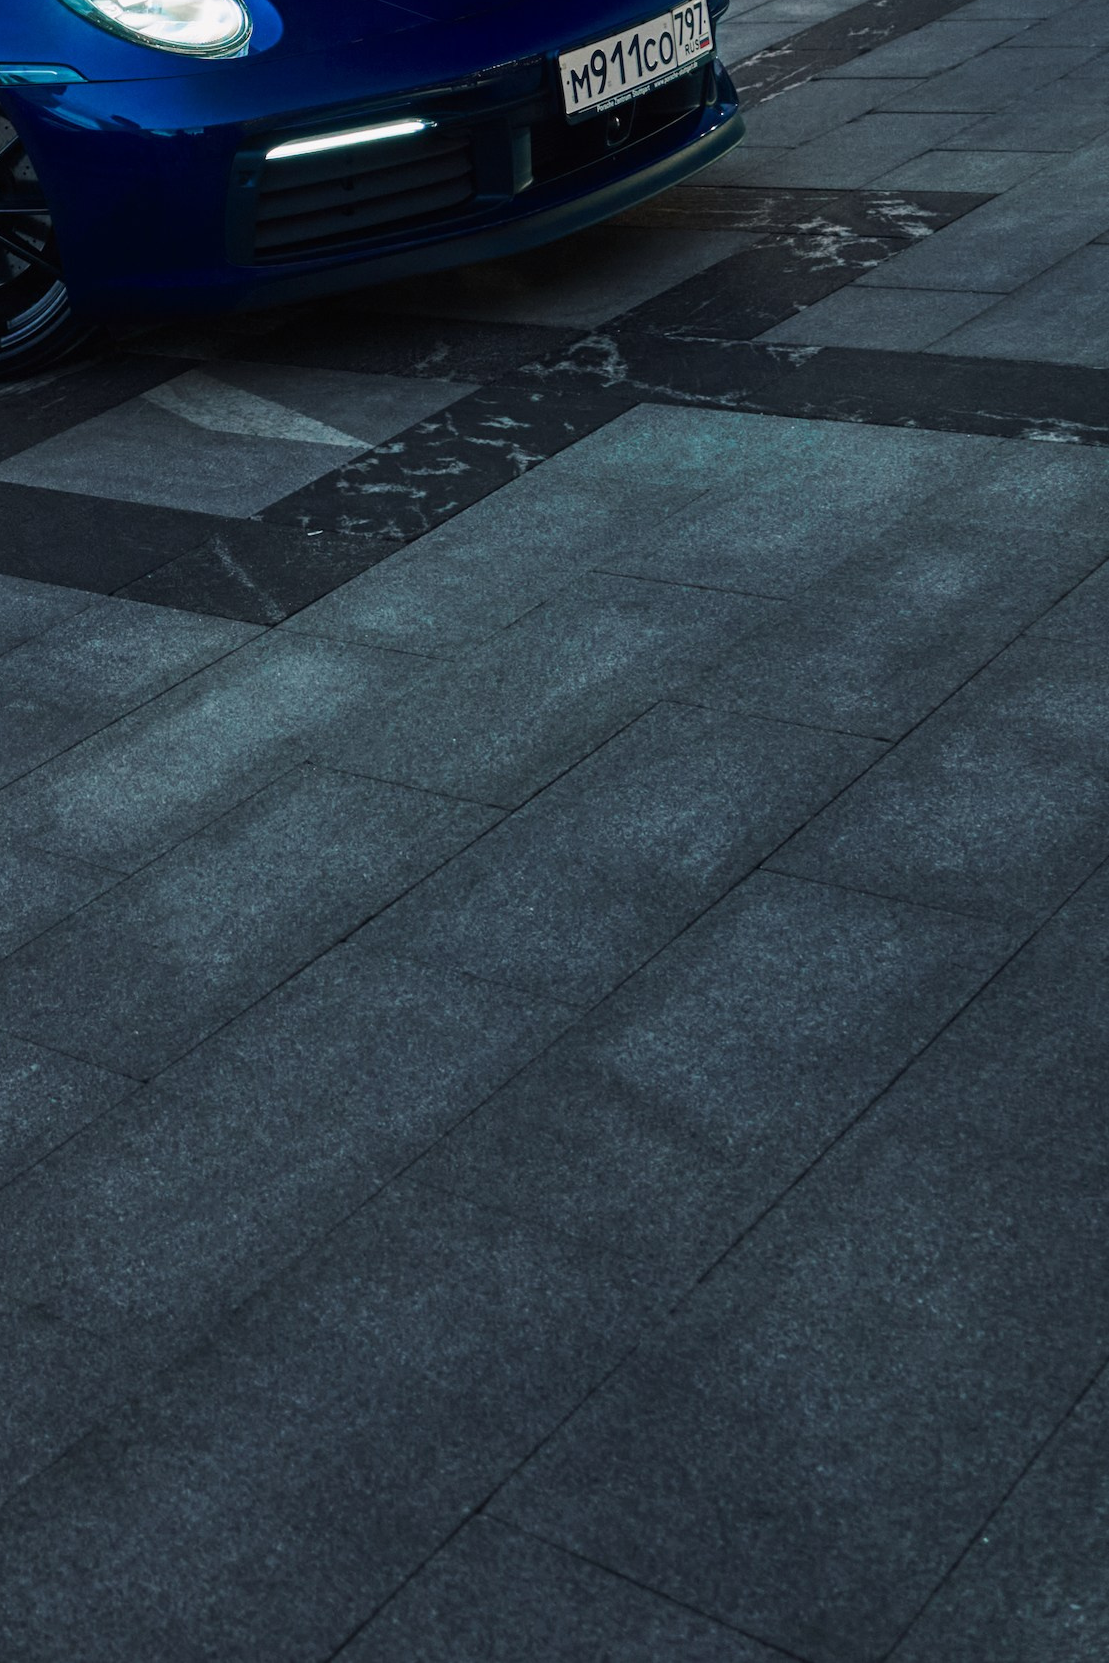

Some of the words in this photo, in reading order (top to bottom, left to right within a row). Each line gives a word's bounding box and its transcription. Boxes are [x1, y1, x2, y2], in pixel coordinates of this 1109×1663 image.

[570, 31, 674, 105] М911СО
[674, 1, 704, 46] 797
[685, 41, 700, 56] RUS
[596, 98, 616, 113] Porsche
